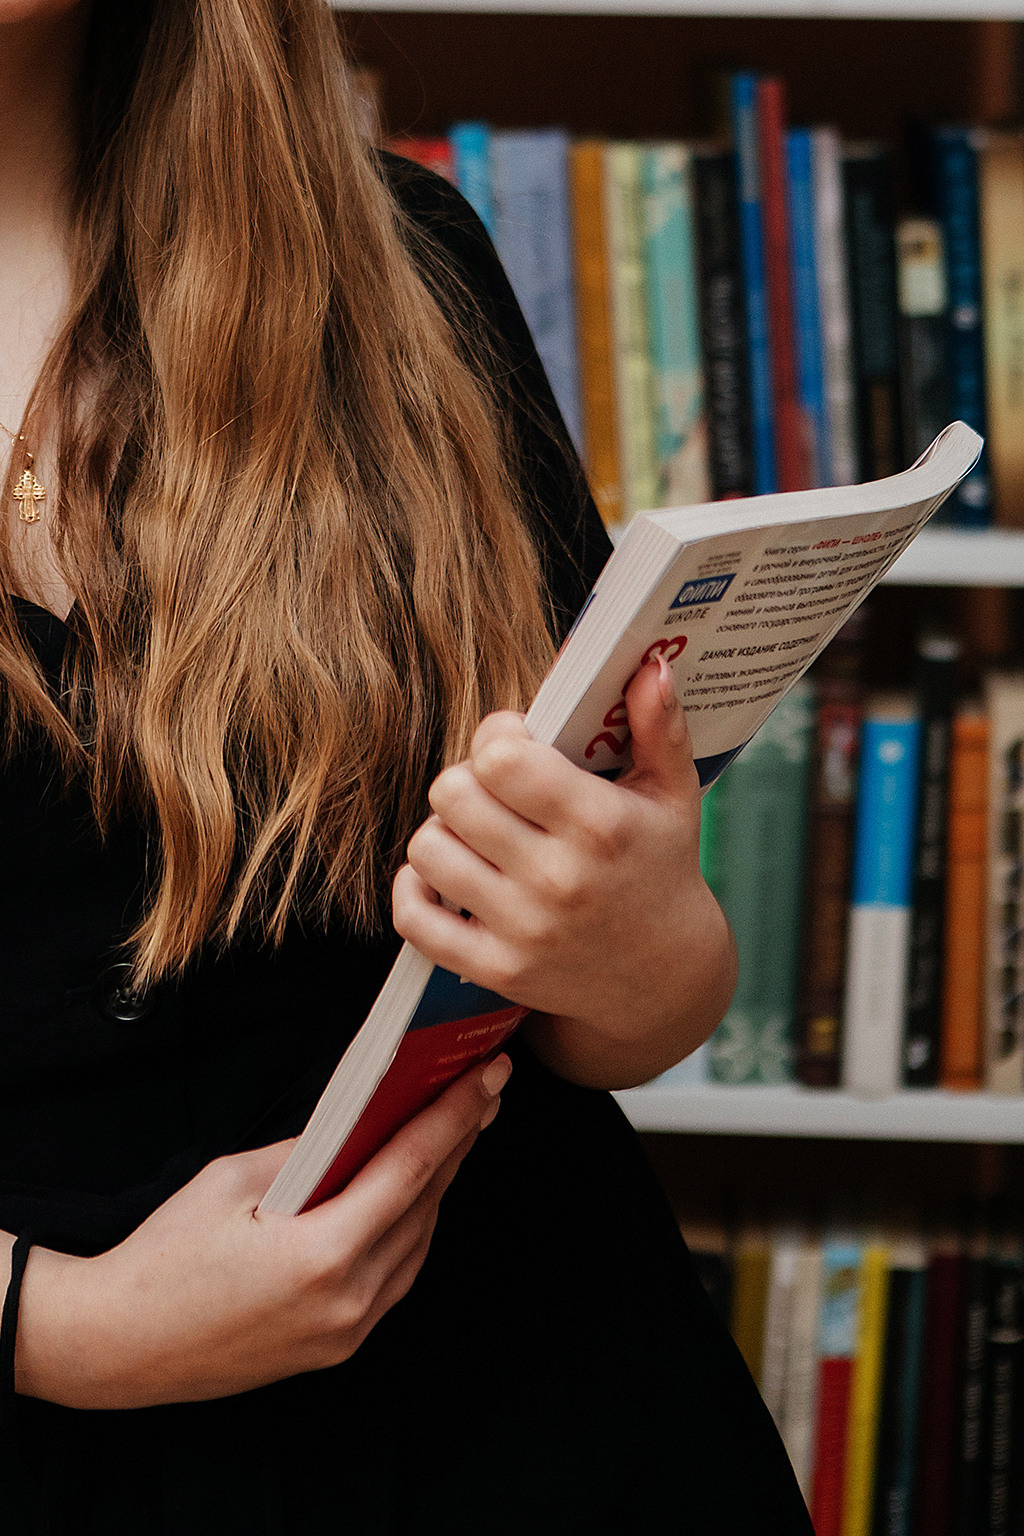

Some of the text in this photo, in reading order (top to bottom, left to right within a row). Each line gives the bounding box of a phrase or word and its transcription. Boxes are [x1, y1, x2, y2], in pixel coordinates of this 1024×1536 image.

[678, 579, 729, 604] ФИПИ
[664, 606, 711, 626] ШКОЛЕ
[699, 648, 738, 663] ДАННОЕ
[737, 641, 779, 657] ИЗДАНИЕ
